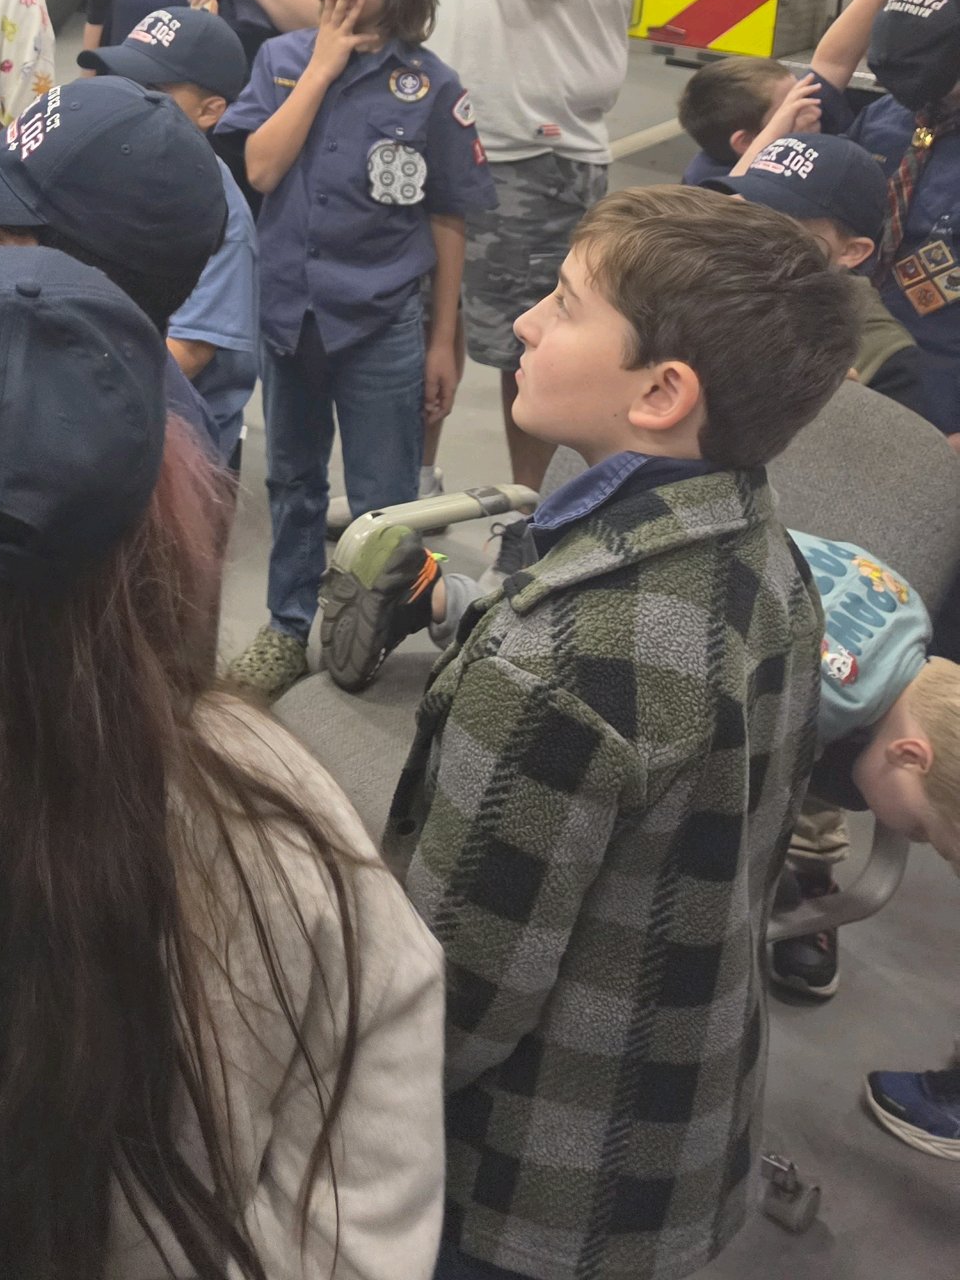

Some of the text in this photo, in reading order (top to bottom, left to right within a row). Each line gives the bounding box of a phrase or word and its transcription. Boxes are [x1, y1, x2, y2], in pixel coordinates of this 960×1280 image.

[150, 21, 176, 47] 102
[20, 112, 44, 160] 102
[782, 150, 814, 179] 102
[827, 575, 898, 656] PAW
